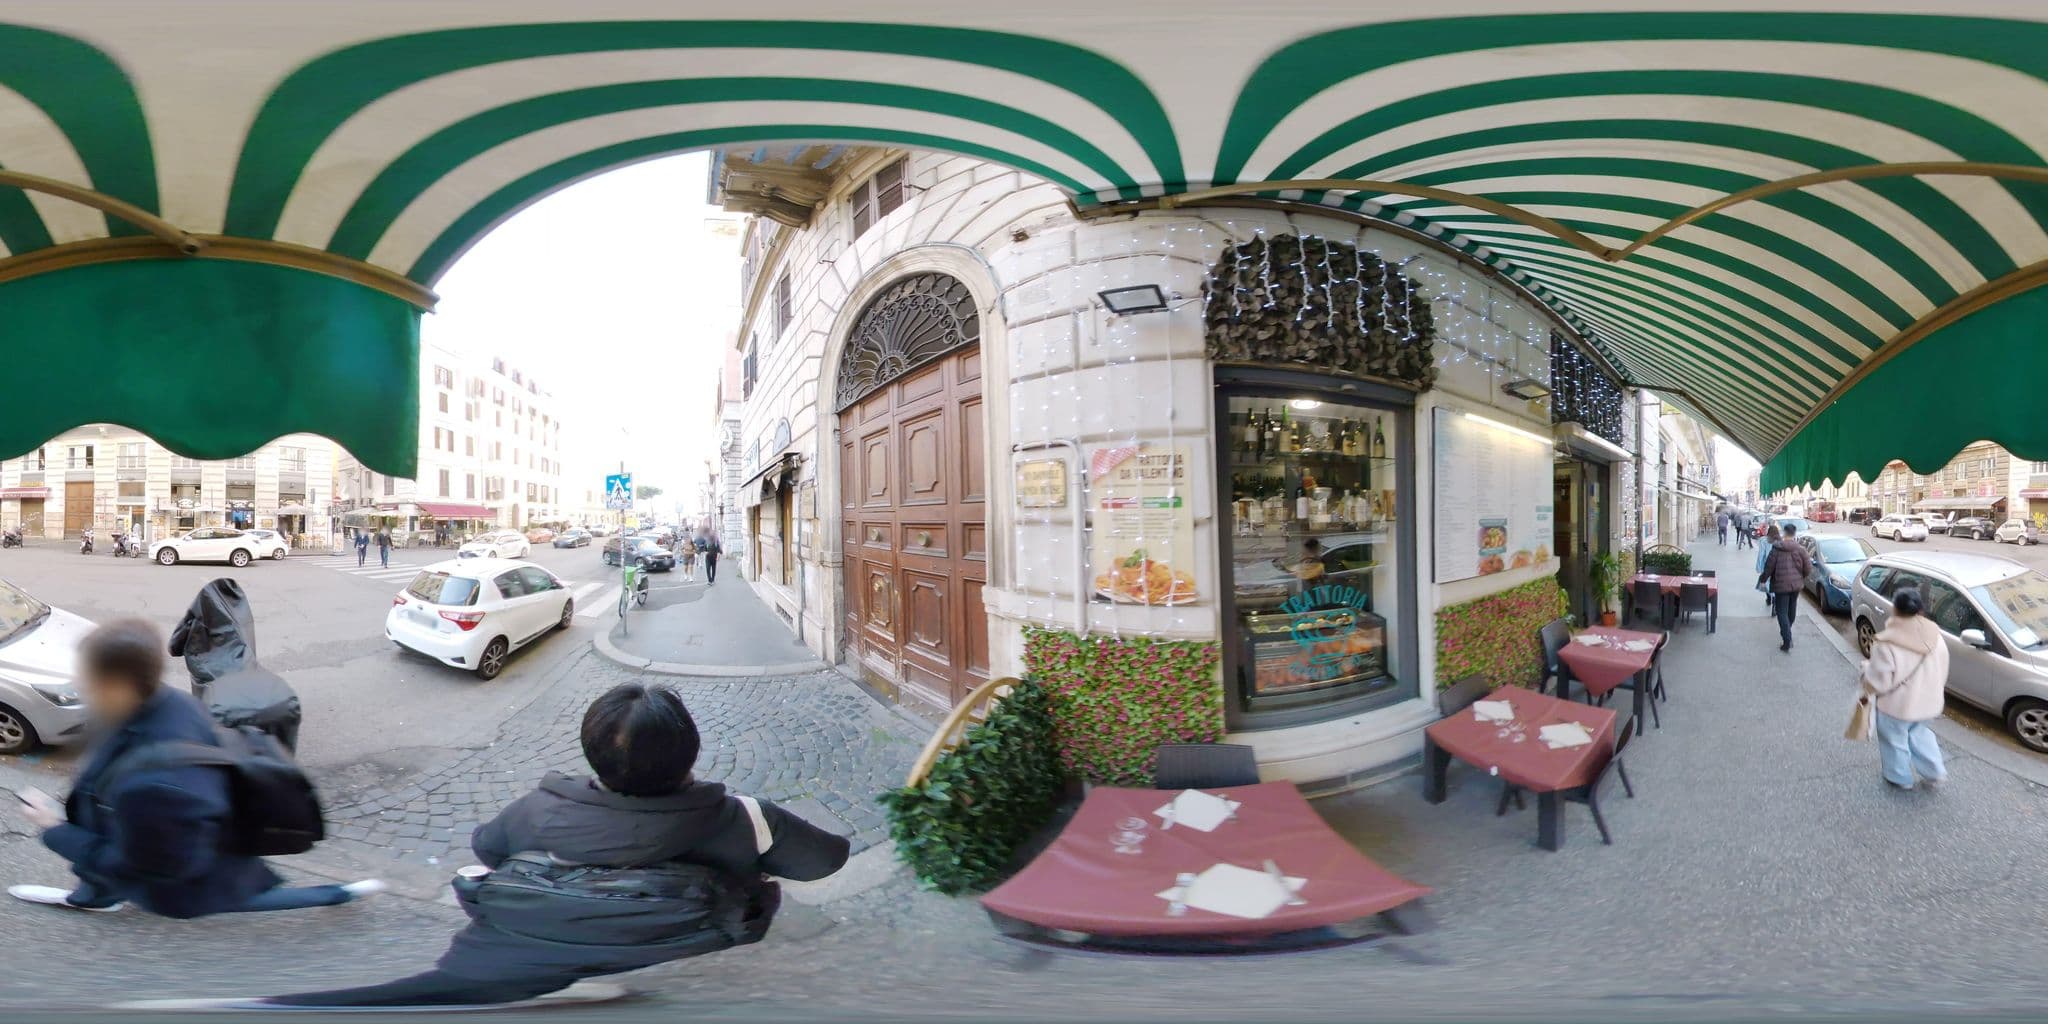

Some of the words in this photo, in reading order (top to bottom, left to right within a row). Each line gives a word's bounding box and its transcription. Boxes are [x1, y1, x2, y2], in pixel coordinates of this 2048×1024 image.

[1120, 469, 1131, 480] DA
[1136, 467, 1184, 479] ALENTNO
[1279, 584, 1368, 615] TRATTORIA
